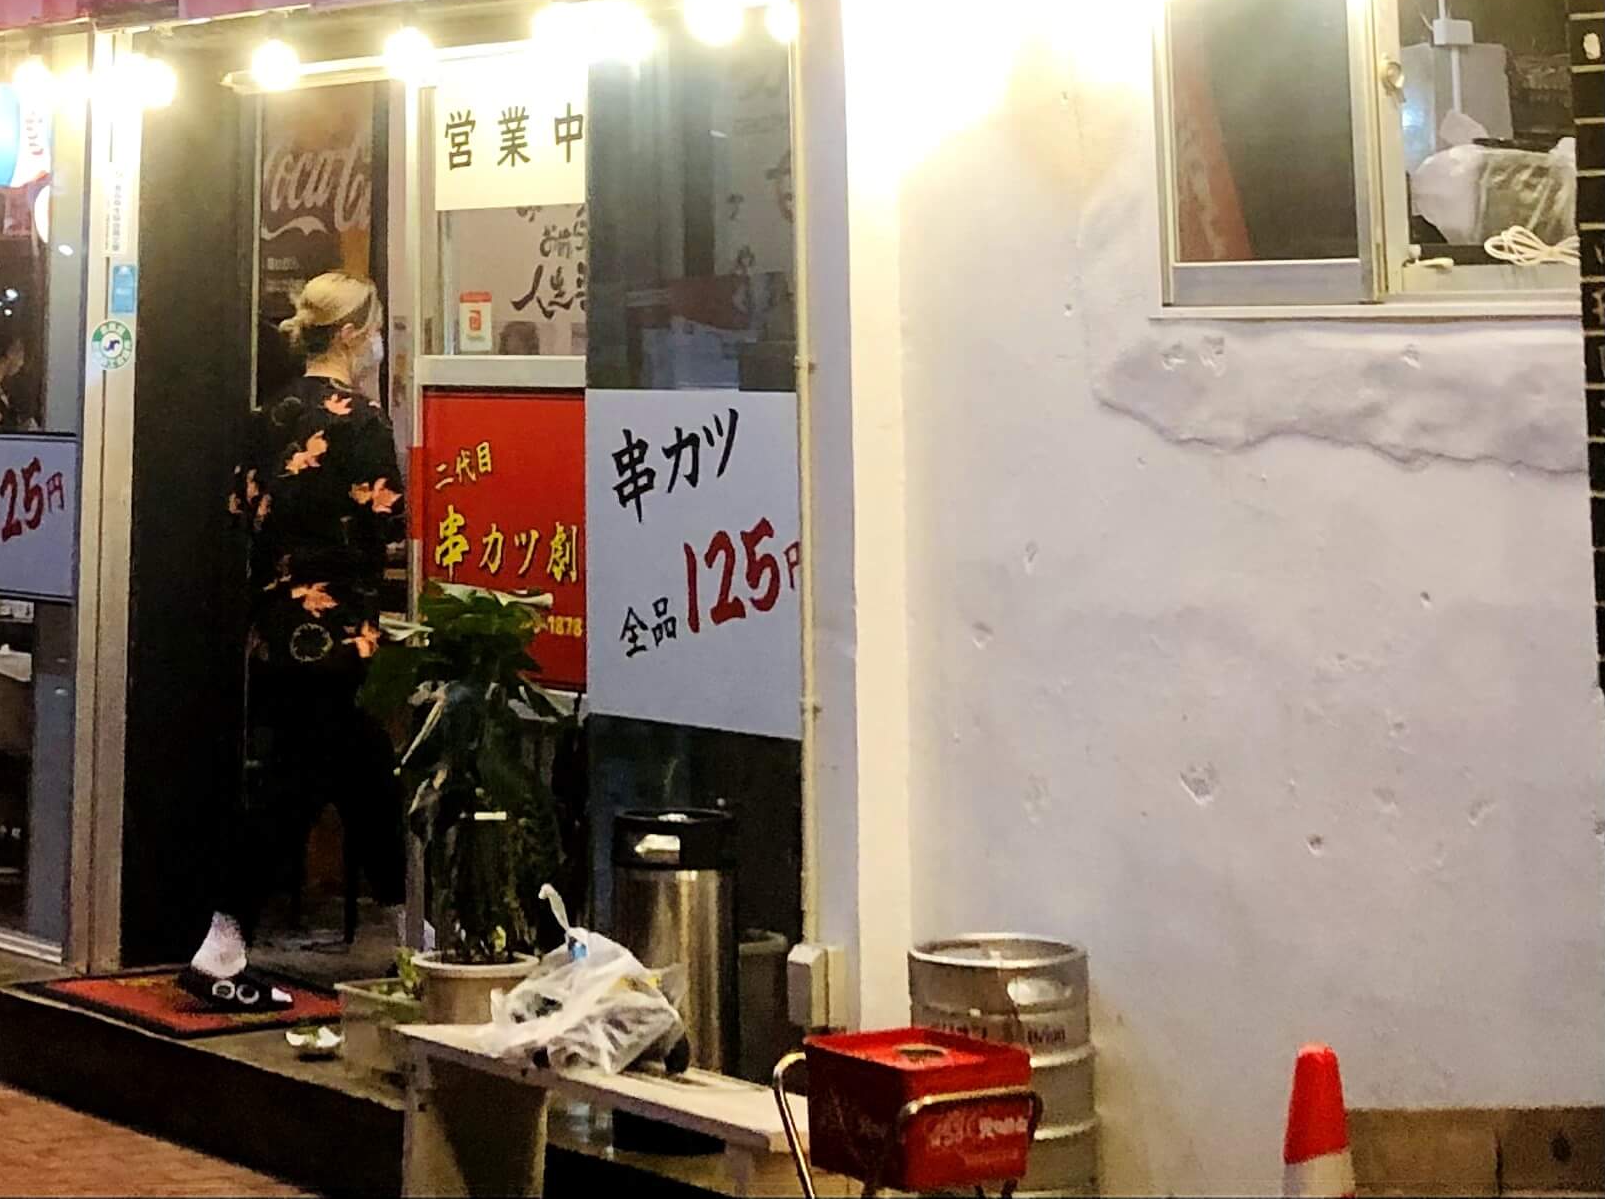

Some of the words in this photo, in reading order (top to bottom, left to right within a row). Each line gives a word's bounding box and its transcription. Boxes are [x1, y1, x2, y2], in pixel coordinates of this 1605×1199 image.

[444, 102, 584, 171] 営業中
[435, 441, 493, 491] 二代目
[611, 408, 739, 524] 串カツ
[434, 505, 578, 584] 串カツ劇
